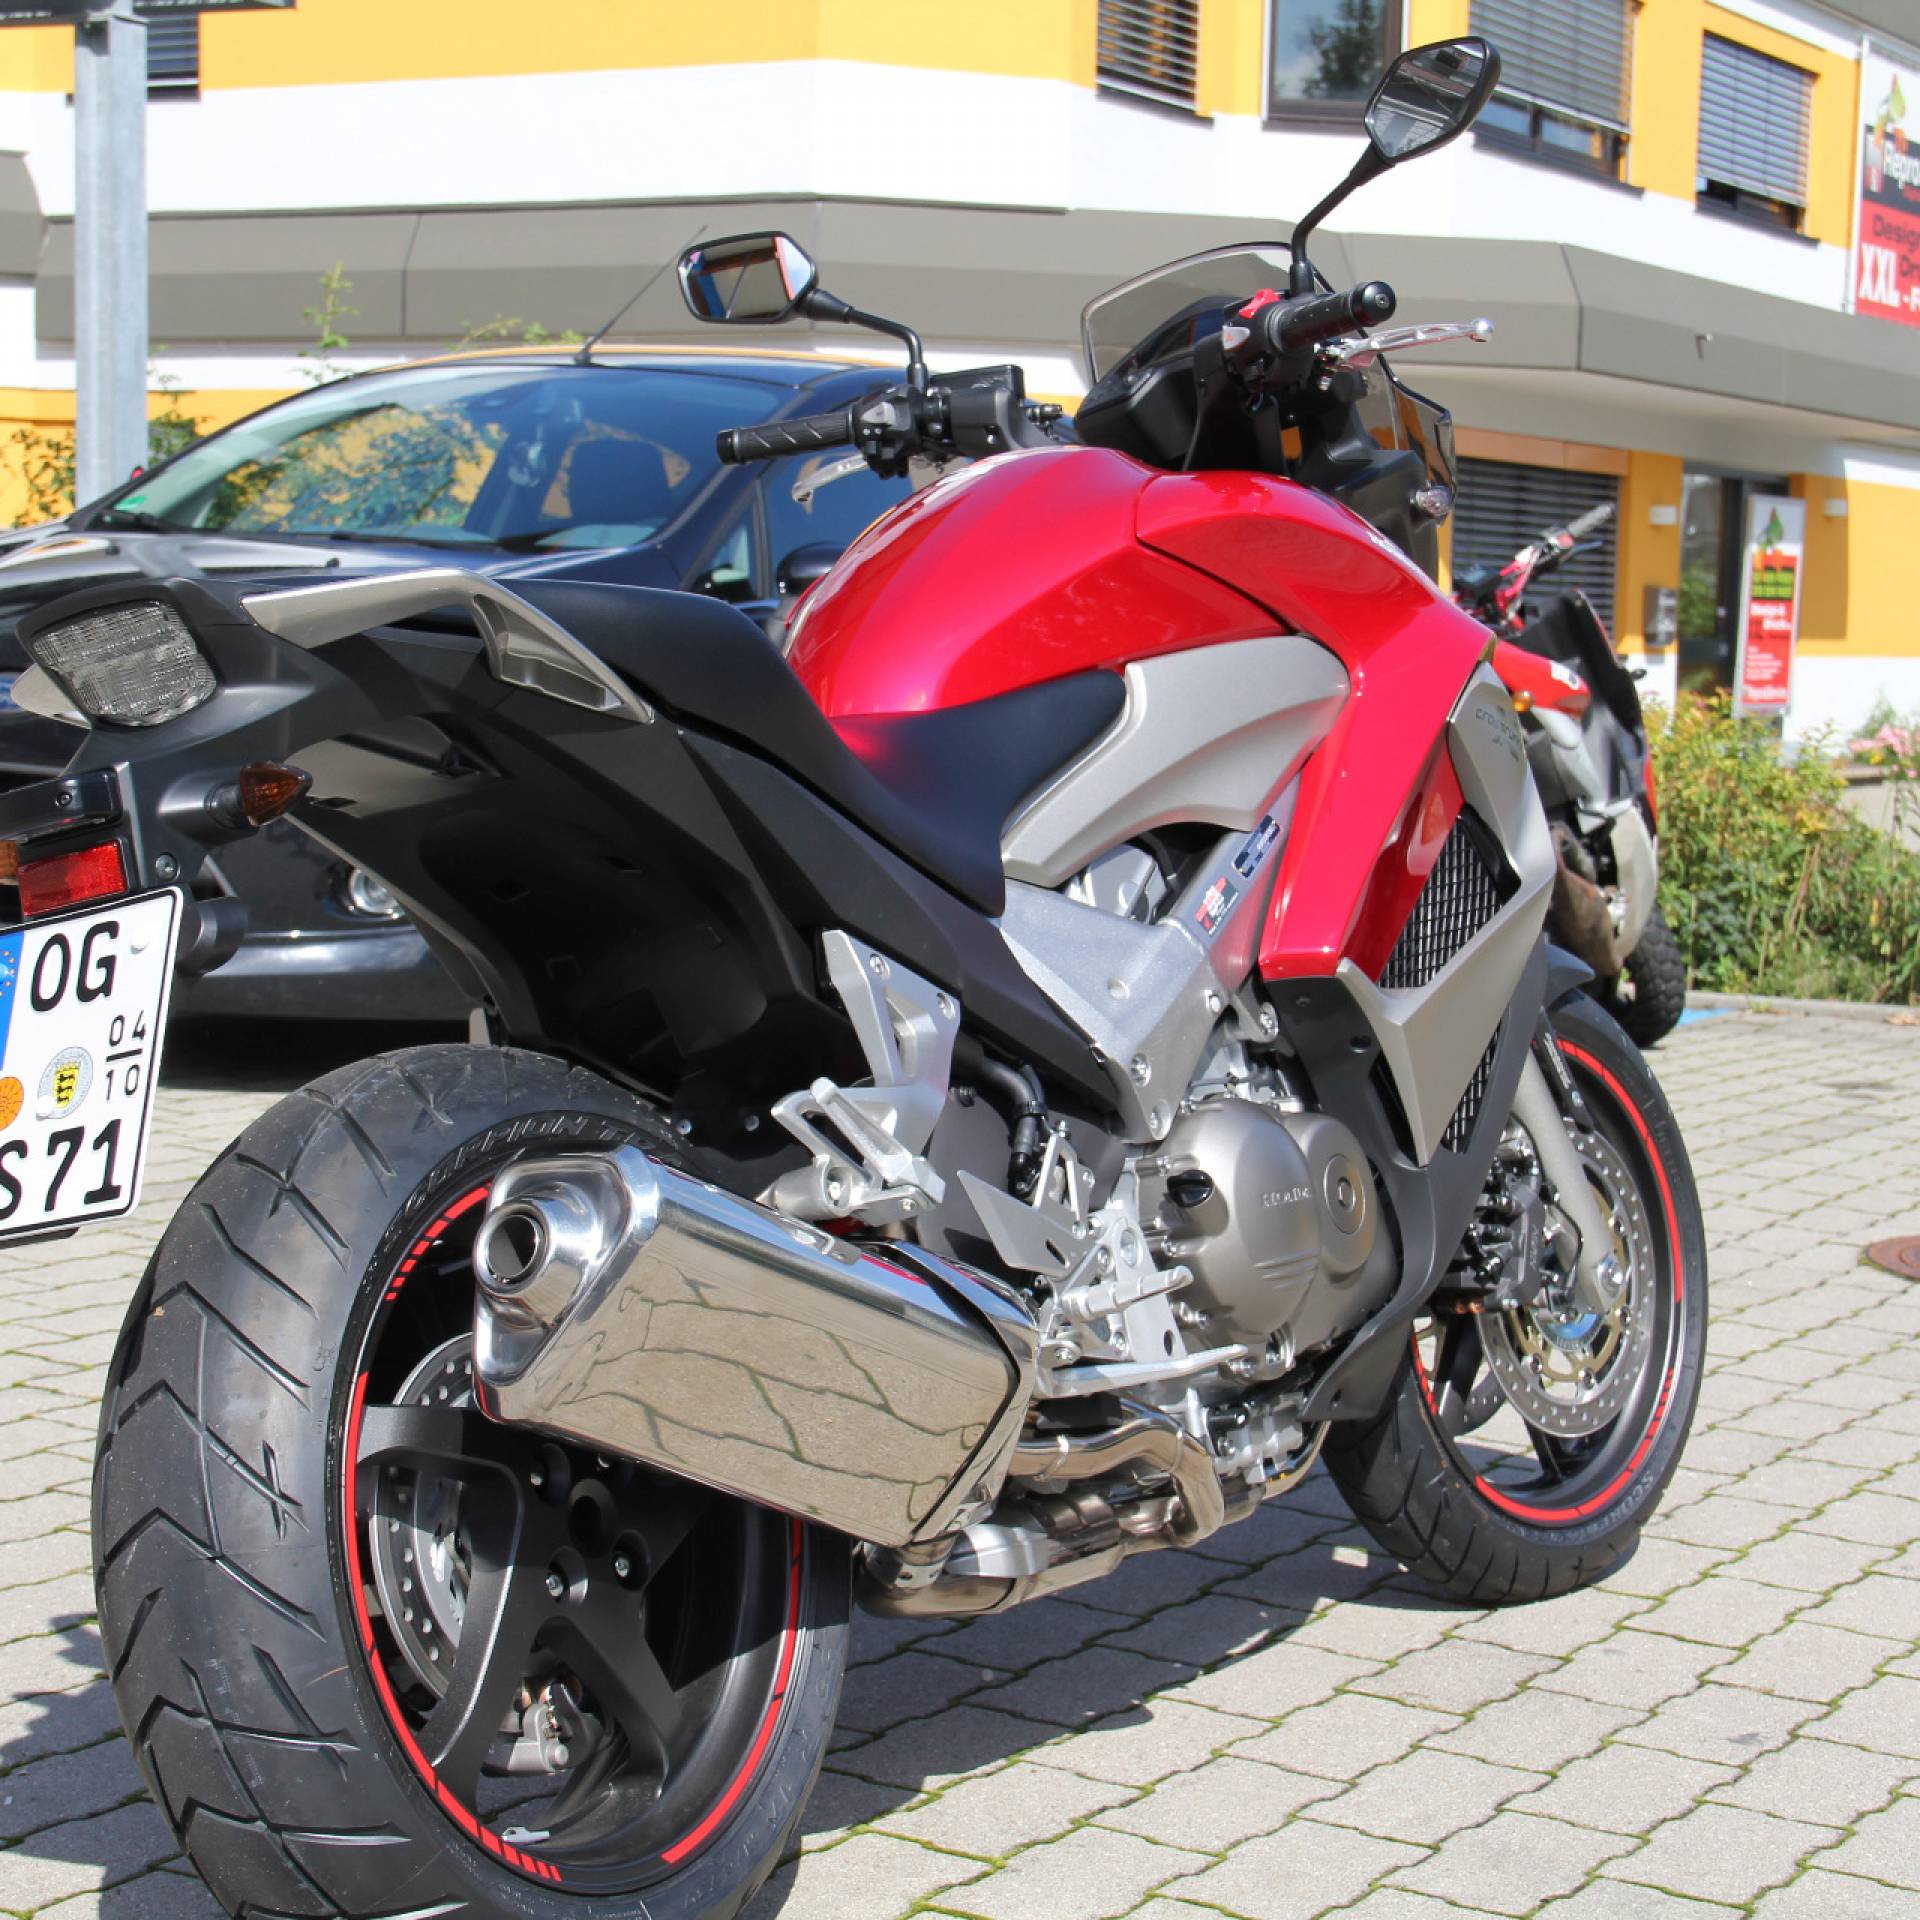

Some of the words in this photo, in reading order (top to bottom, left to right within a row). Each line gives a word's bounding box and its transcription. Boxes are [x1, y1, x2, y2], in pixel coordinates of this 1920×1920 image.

[1858, 241, 1900, 308] XXL
[31, 920, 119, 1012] OG
[109, 1009, 146, 1047] 04
[106, 1064, 140, 1101] 10
